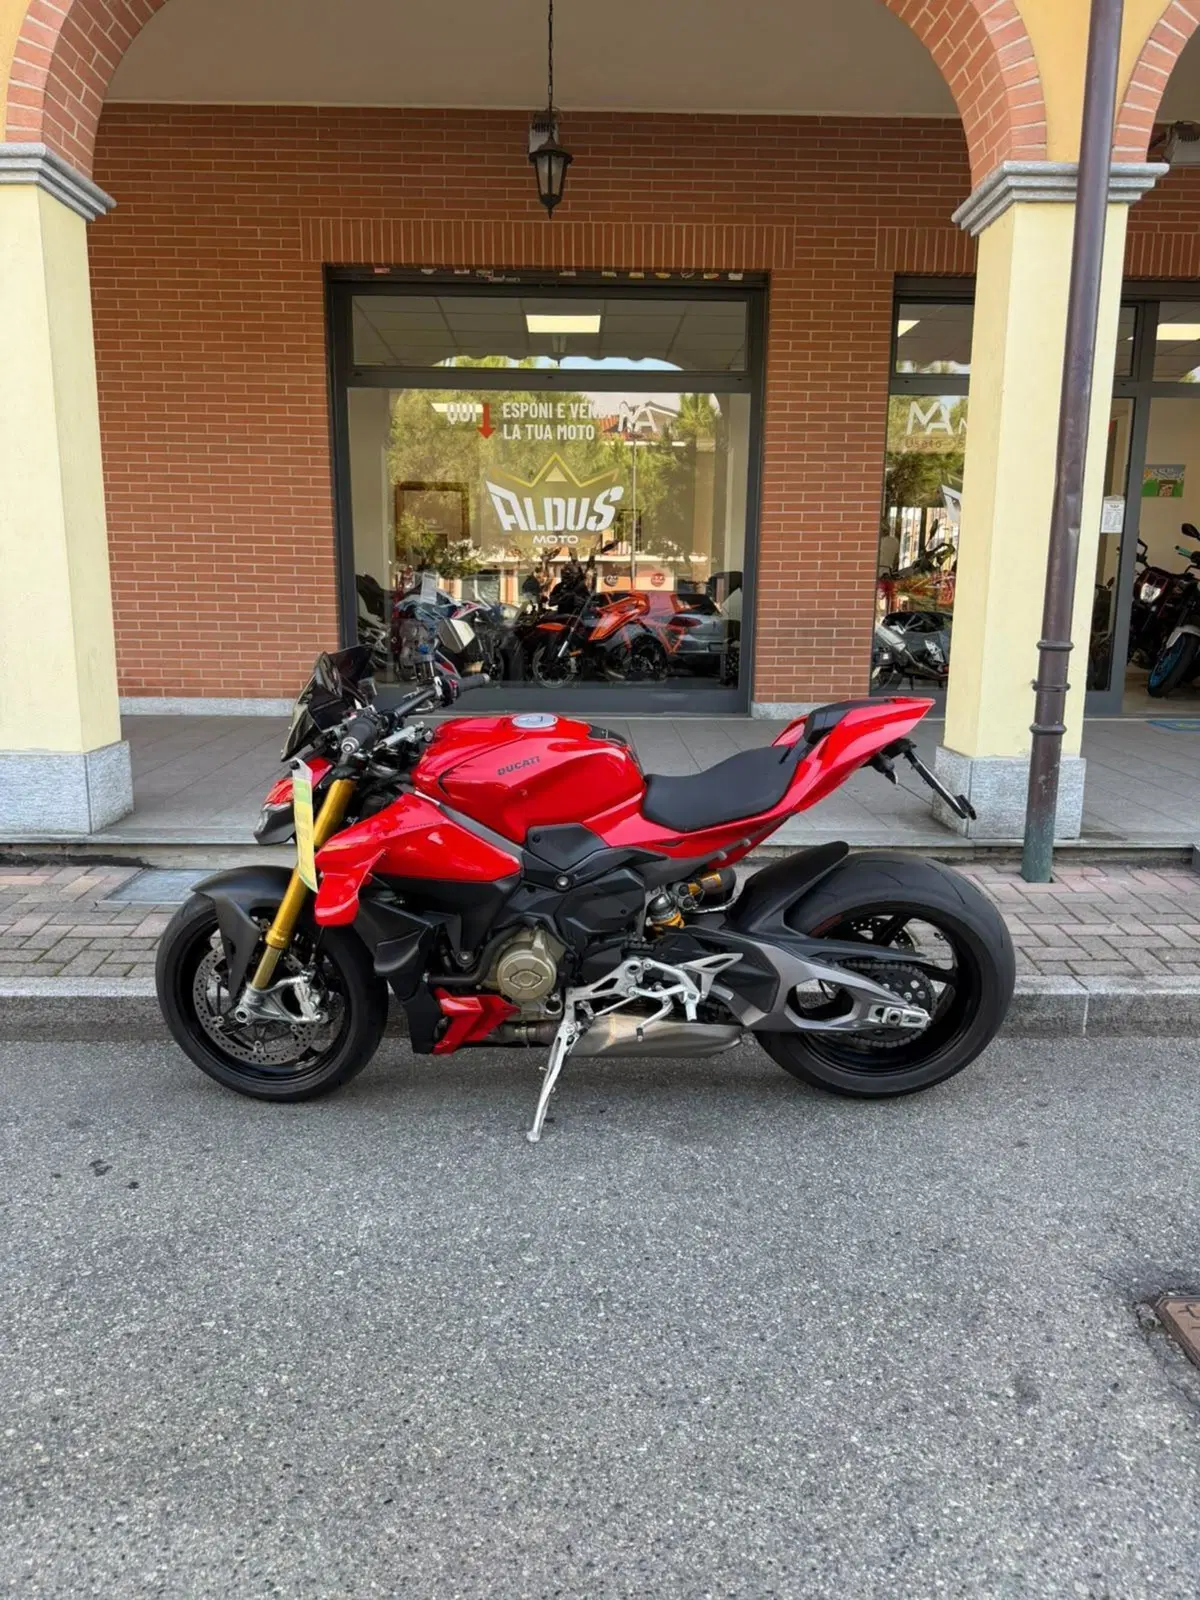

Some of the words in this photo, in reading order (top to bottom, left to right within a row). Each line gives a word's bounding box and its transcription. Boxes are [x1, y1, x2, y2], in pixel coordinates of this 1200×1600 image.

[447, 402, 476, 425] QUI
[502, 402, 553, 419] ESPONI
[557, 402, 564, 419] E
[503, 424, 521, 440] LA
[525, 424, 552, 440] TUA
[557, 424, 595, 440] MOTO
[485, 480, 624, 532] ALDUS
[532, 534, 579, 545] MOTO
[497, 755, 540, 776] DUCATI
